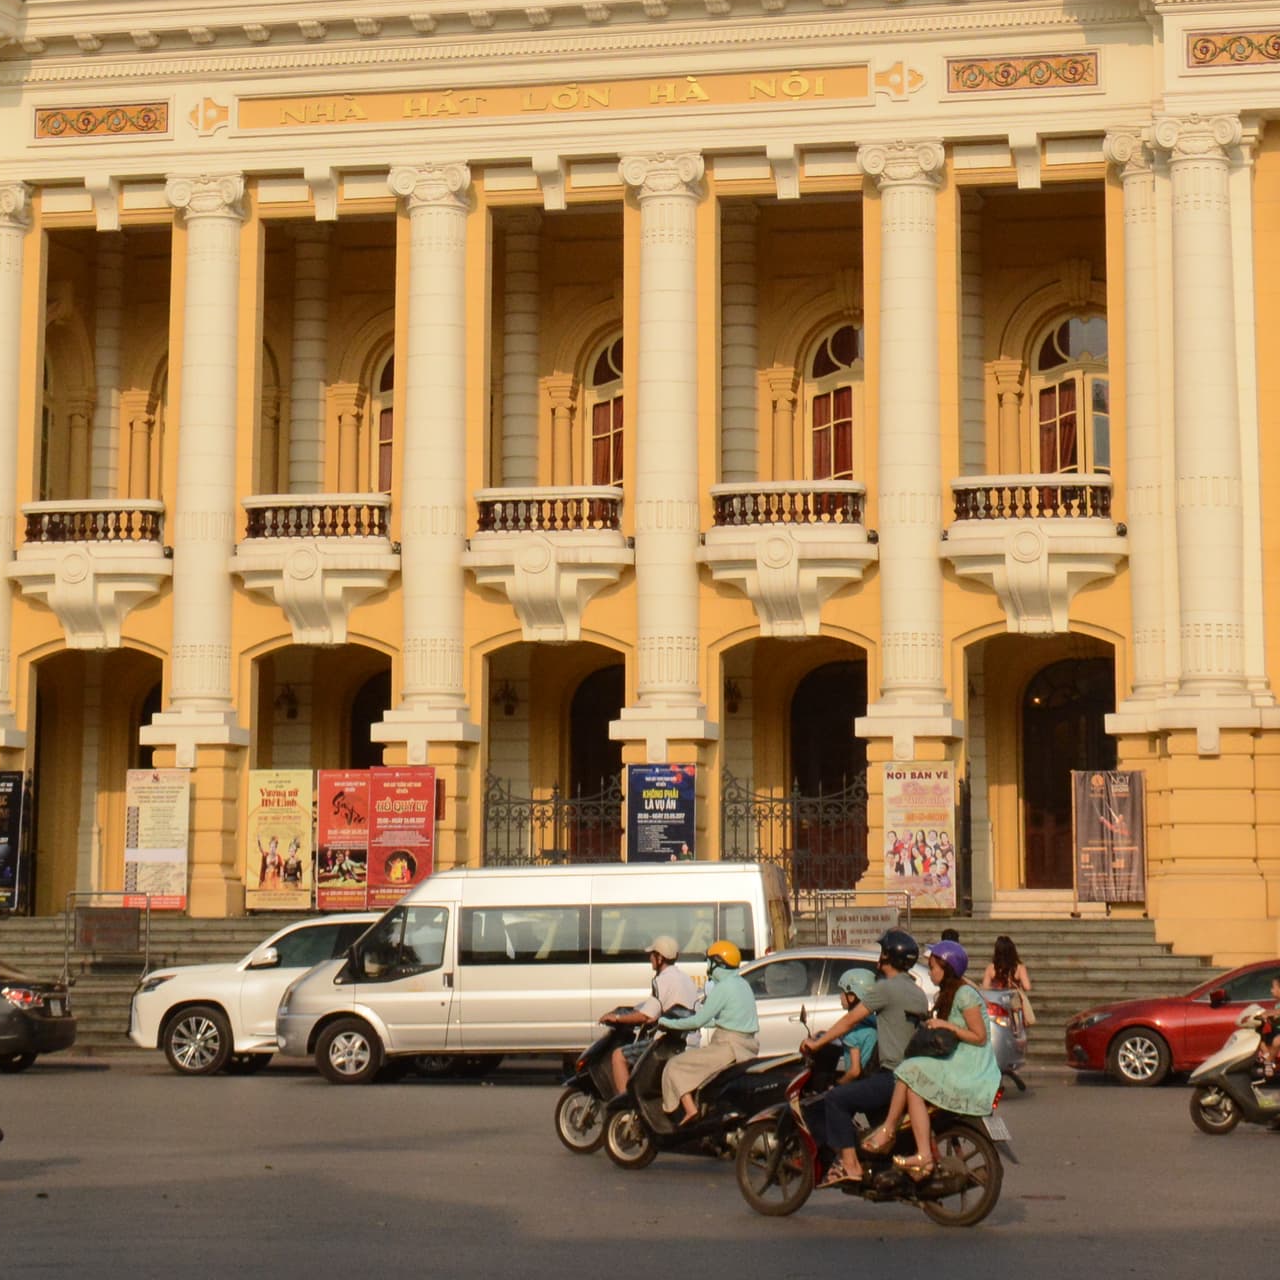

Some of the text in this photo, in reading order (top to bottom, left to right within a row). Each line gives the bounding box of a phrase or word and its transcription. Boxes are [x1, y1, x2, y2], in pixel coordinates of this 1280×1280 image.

[279, 70, 825, 124] NHÀ HÁT LỚN HÀ NỘI
